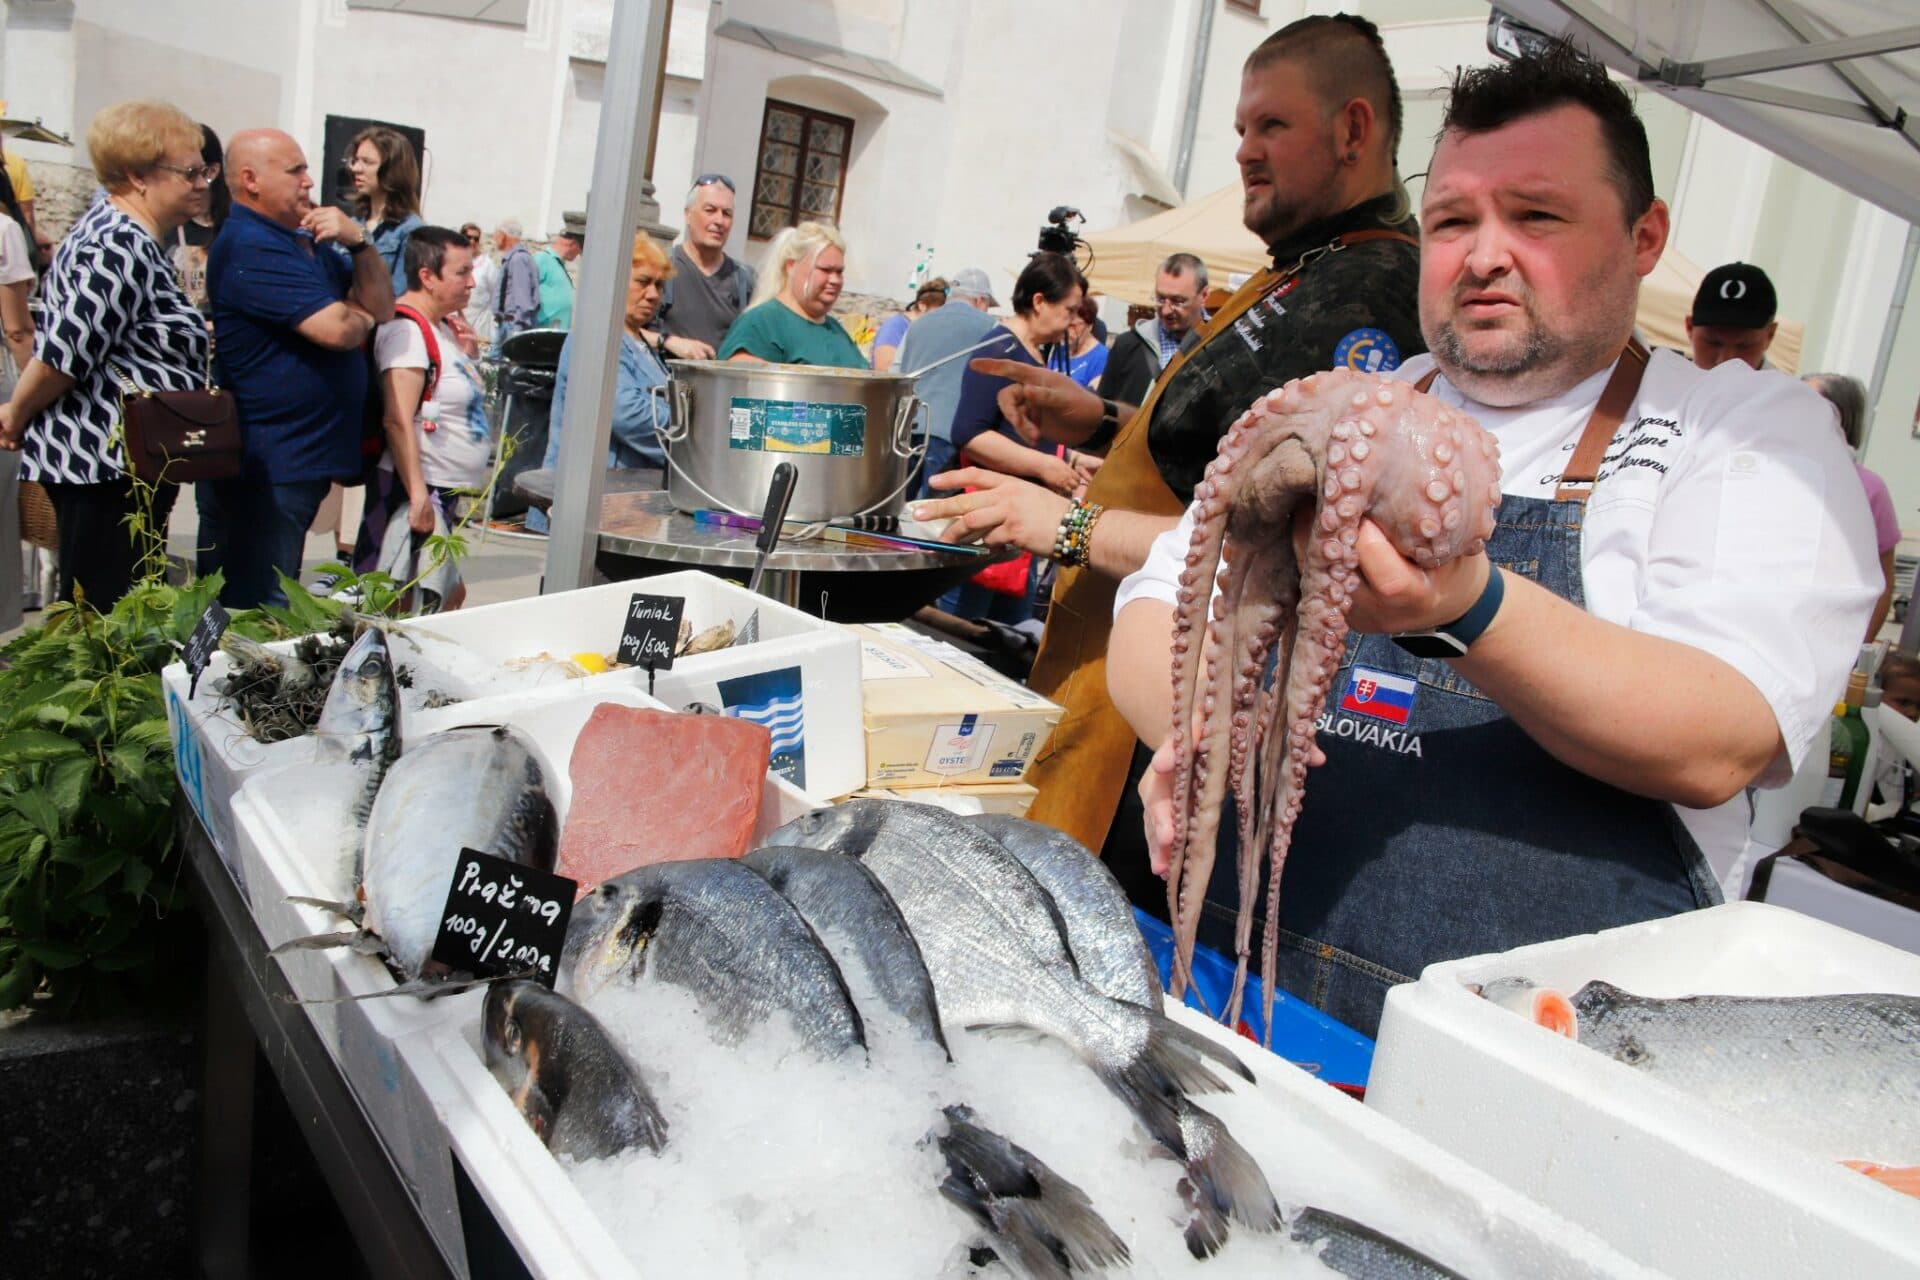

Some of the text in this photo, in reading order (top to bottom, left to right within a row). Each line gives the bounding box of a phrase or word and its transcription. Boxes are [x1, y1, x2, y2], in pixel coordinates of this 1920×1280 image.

[631, 600, 674, 620] Tuniak
[1314, 713, 1422, 757] SLOVAKIA
[457, 861, 561, 926] Pražma
